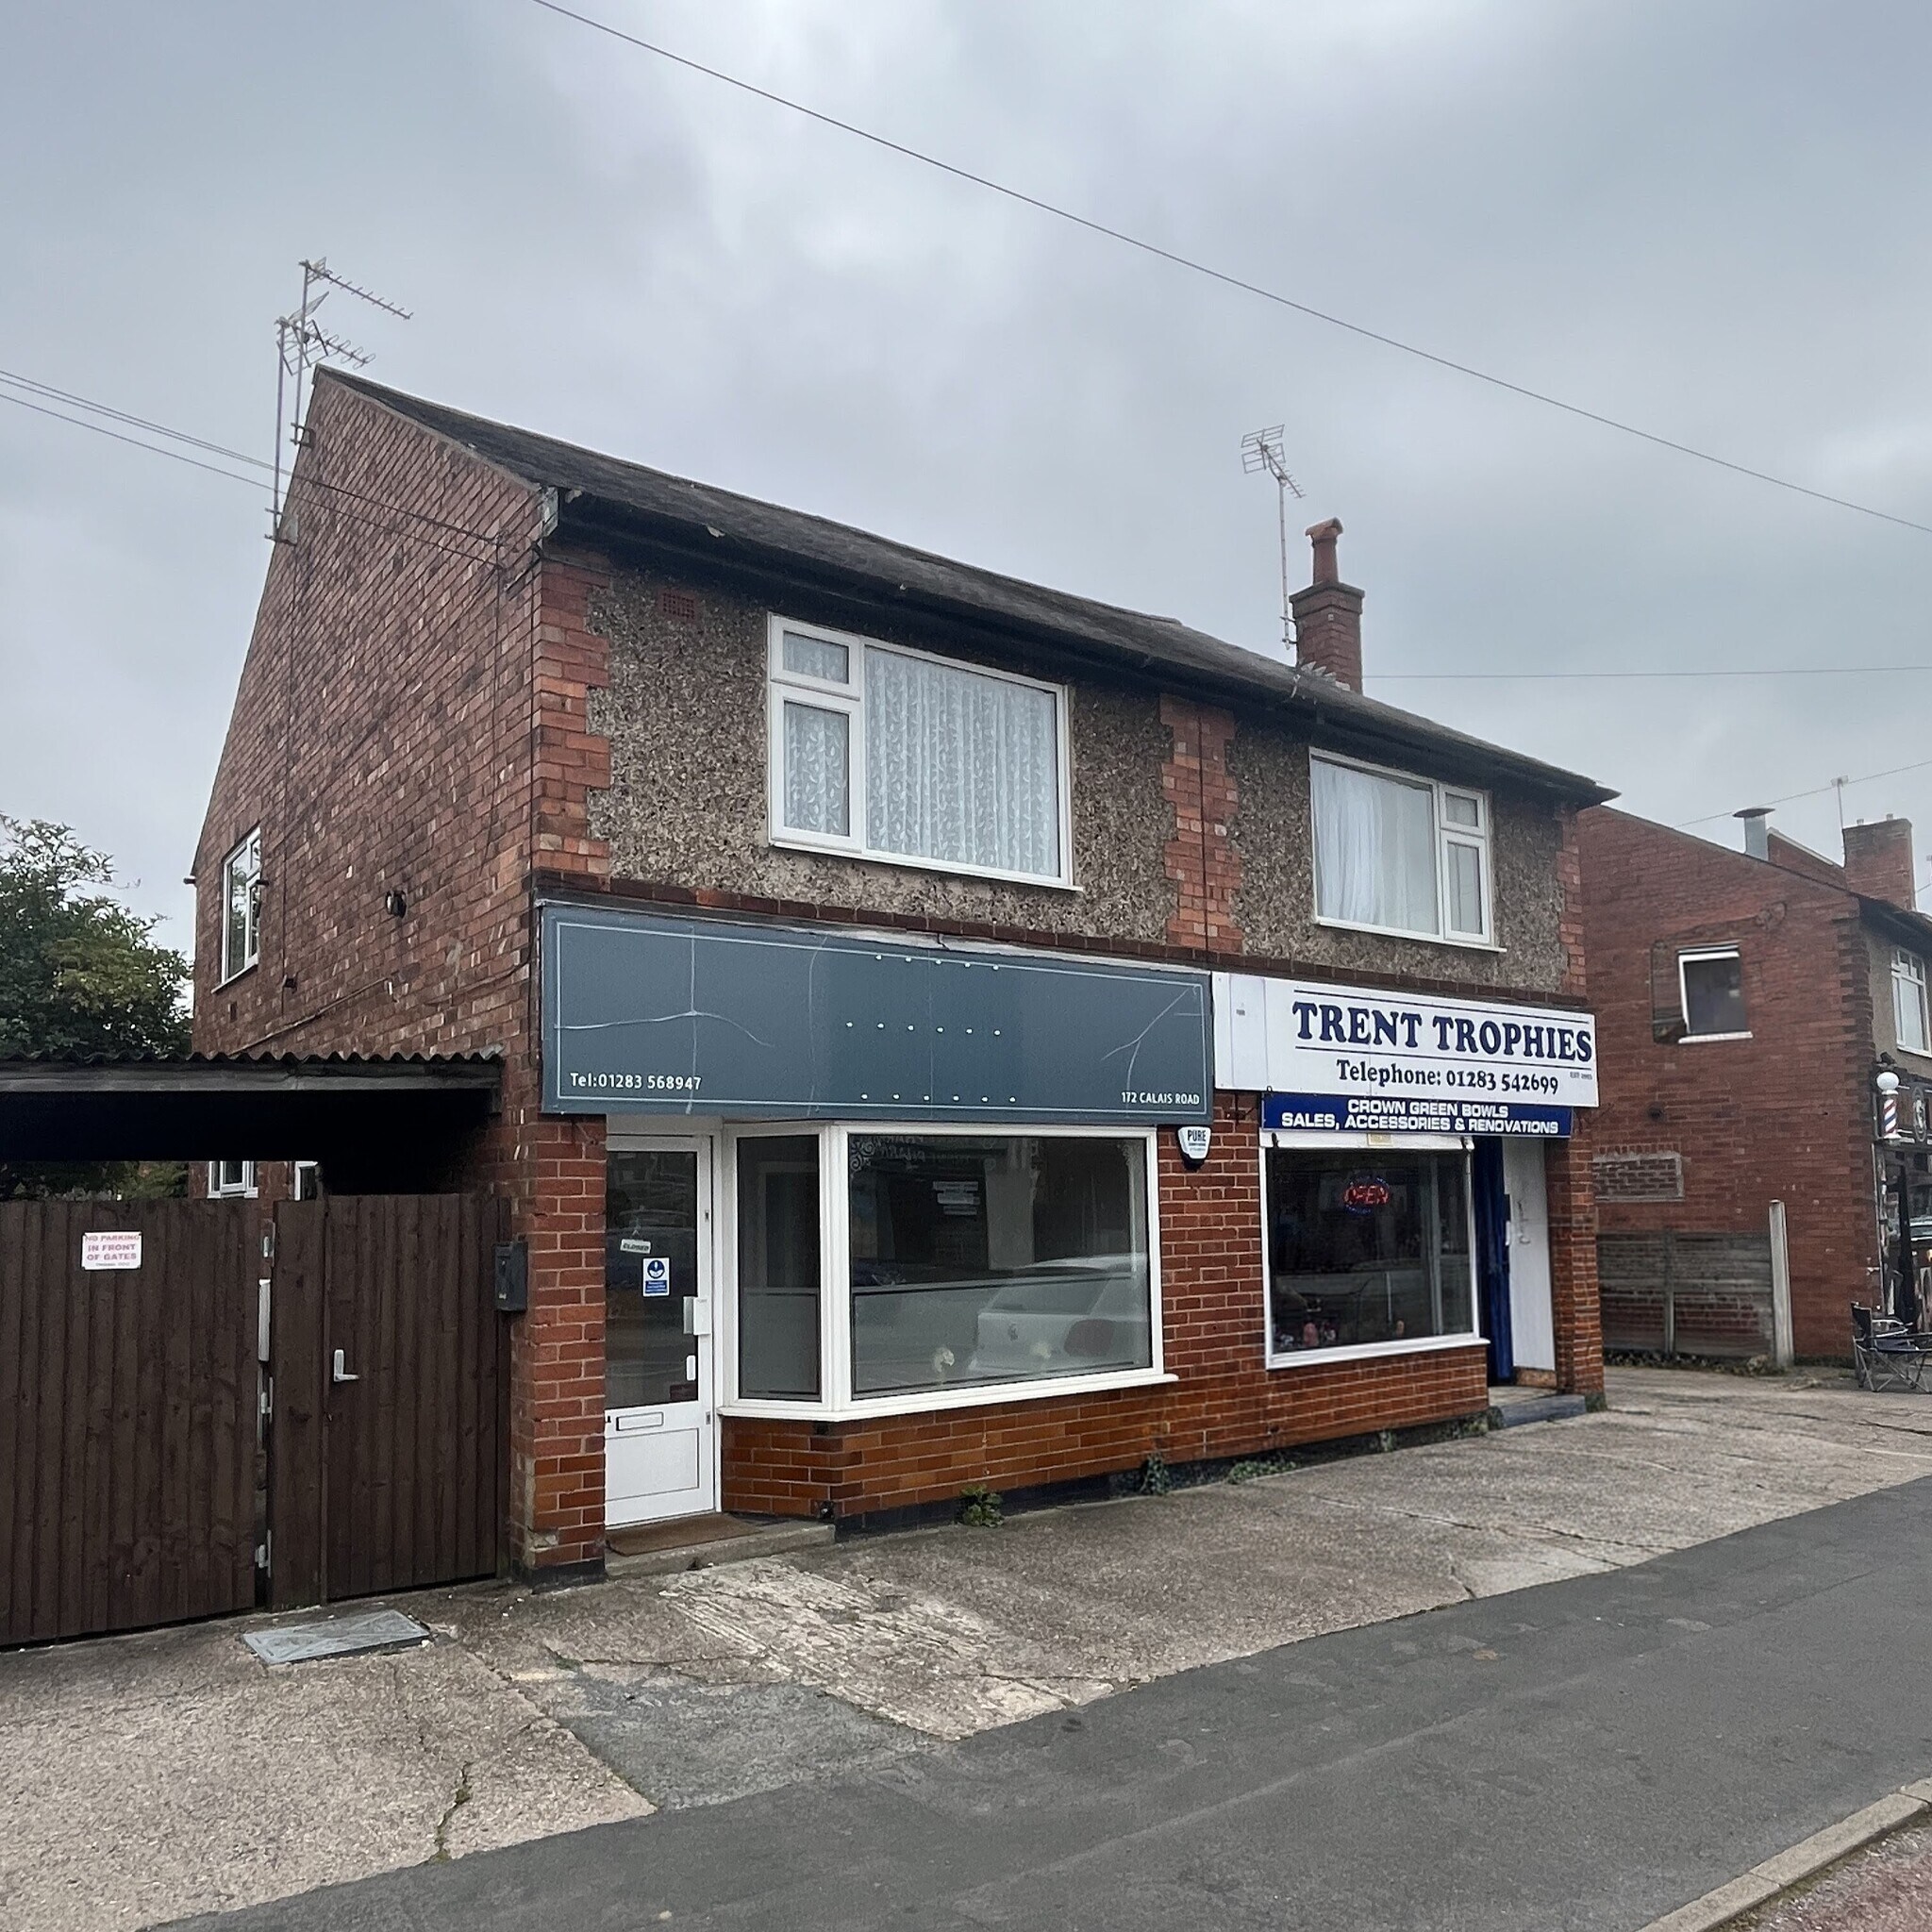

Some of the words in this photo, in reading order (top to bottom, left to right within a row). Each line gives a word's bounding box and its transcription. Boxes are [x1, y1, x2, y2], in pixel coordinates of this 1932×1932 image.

[1292, 1002, 1423, 1048] TRENT
[1433, 1016, 1592, 1062] TROPHIES
[570, 1073, 642, 1089] Tel:01283
[647, 1074, 702, 1091] 568947
[1337, 1059, 1441, 1087] Telephone:
[1446, 1070, 1496, 1091] 01283
[1502, 1073, 1558, 1094] 542699
[1122, 1091, 1137, 1103] 172
[1140, 1092, 1173, 1104] CALAIS
[1174, 1093, 1200, 1105] ROAD
[1348, 1099, 1407, 1114] CROWN
[1409, 1101, 1458, 1117] GREEN
[1462, 1104, 1508, 1118] BOWLS
[1281, 1112, 1340, 1130] SALES,
[1344, 1114, 1451, 1130] ACCESSORIES
[1454, 1118, 1465, 1131] &
[1468, 1119, 1558, 1134] RENOVATIONS
[1187, 1129, 1206, 1141] PURE
